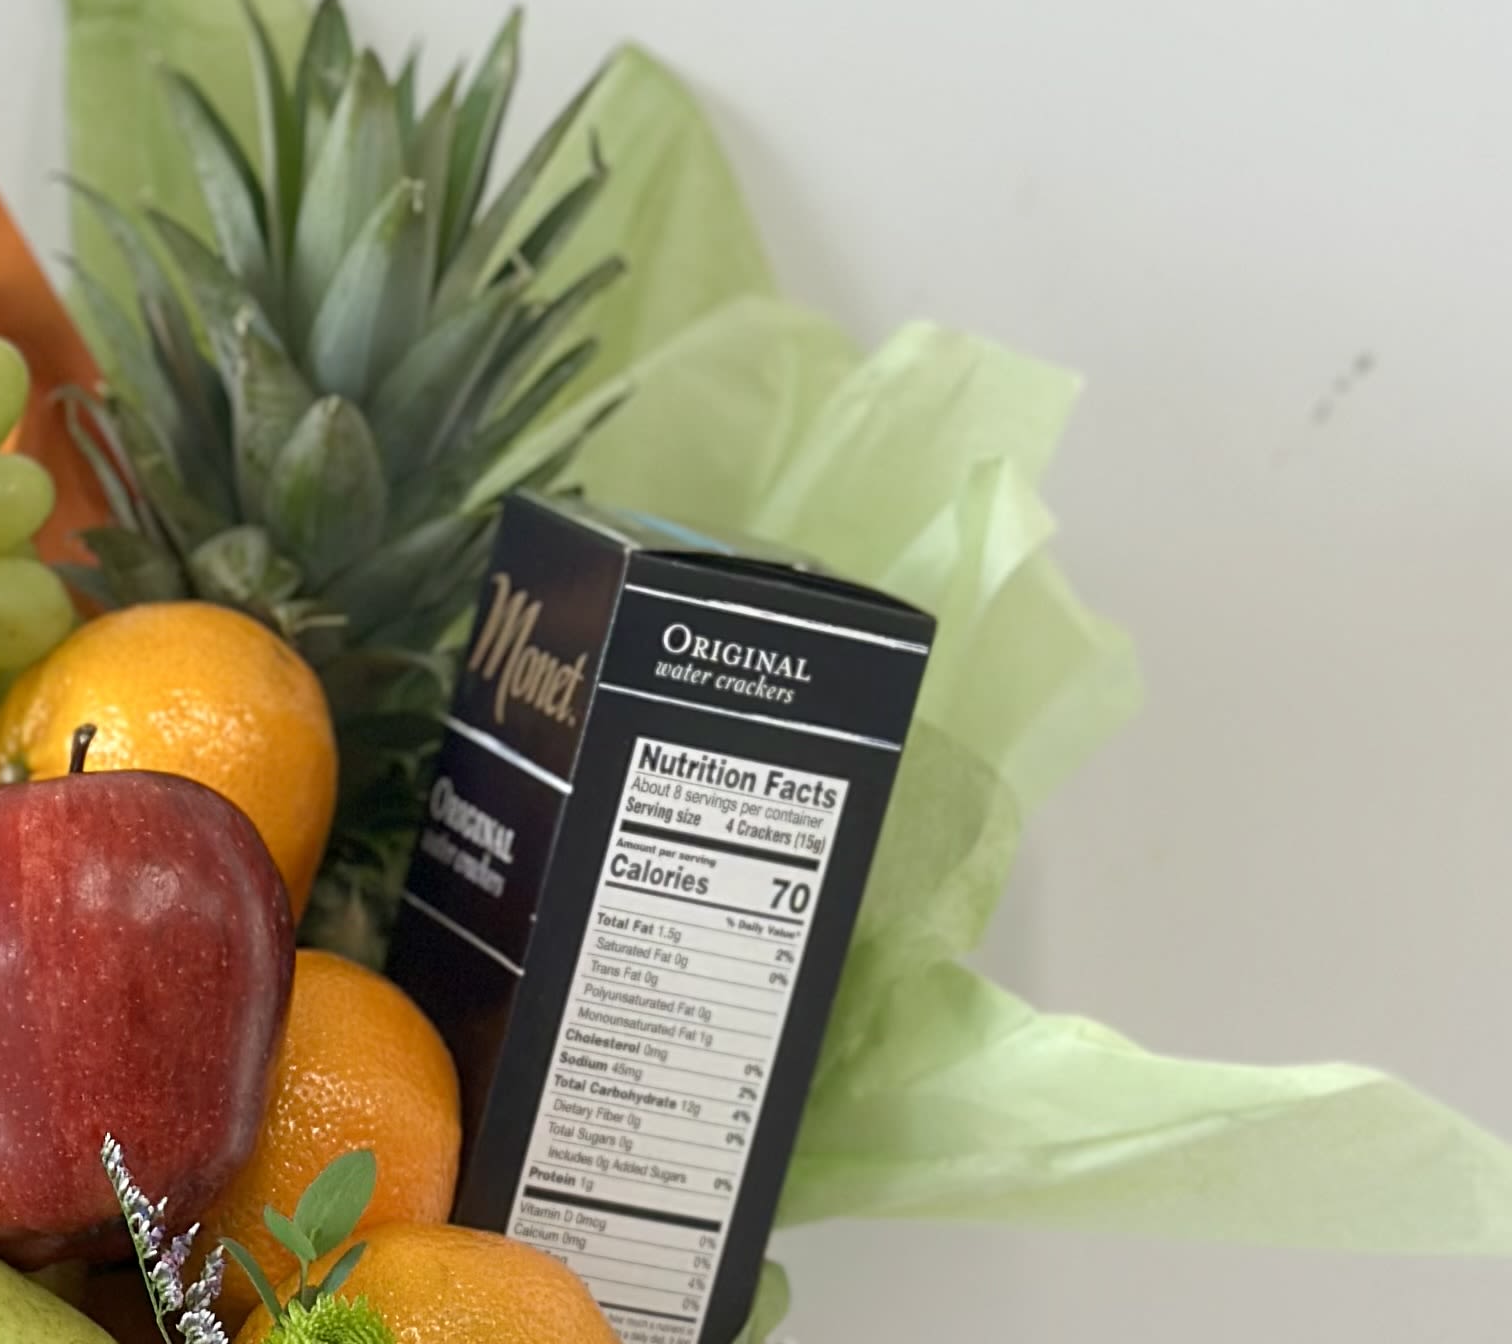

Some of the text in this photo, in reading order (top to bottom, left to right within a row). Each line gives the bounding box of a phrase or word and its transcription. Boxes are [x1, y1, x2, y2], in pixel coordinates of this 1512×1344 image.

[663, 623, 811, 683] ORIGINAL
[655, 660, 796, 705] water crackers
[637, 742, 839, 809] Nutrition Facts
[625, 795, 827, 855] Serving size 4 Crackers (15g)
[631, 775, 824, 830] About 8 servings per container
[616, 837, 717, 869] Amount per serving
[609, 853, 812, 915] Calories 70
[596, 911, 795, 964] Total Fat 1.5g 2%
[738, 919, 764, 937] Daily
[590, 959, 659, 988] Trans Fat 0g
[596, 936, 789, 987] Saturated Fat 0g 0%
[577, 1006, 713, 1047] Monounsaturated Fat 1g
[583, 983, 712, 1022] Polyunsaturated Fat 0g
[559, 1051, 758, 1102] Sodium 45mg 2%
[565, 1028, 764, 1079] Cholesterol 0mg 0%
[553, 1099, 746, 1147] Dietary Fiber 0g 0%
[554, 1074, 752, 1125] Total Carbohydrate 12g 4%
[548, 1121, 633, 1152] Total Sugars 0g
[528, 1166, 594, 1193] Protein 1g
[547, 1146, 733, 1193] Includes 0g Added Sugars 0%
[513, 1223, 712, 1271] Calcium 0mg 0%
[519, 1201, 717, 1249] Vitamin D 0mcg 0%
[687, 1277, 706, 1292] 4%
